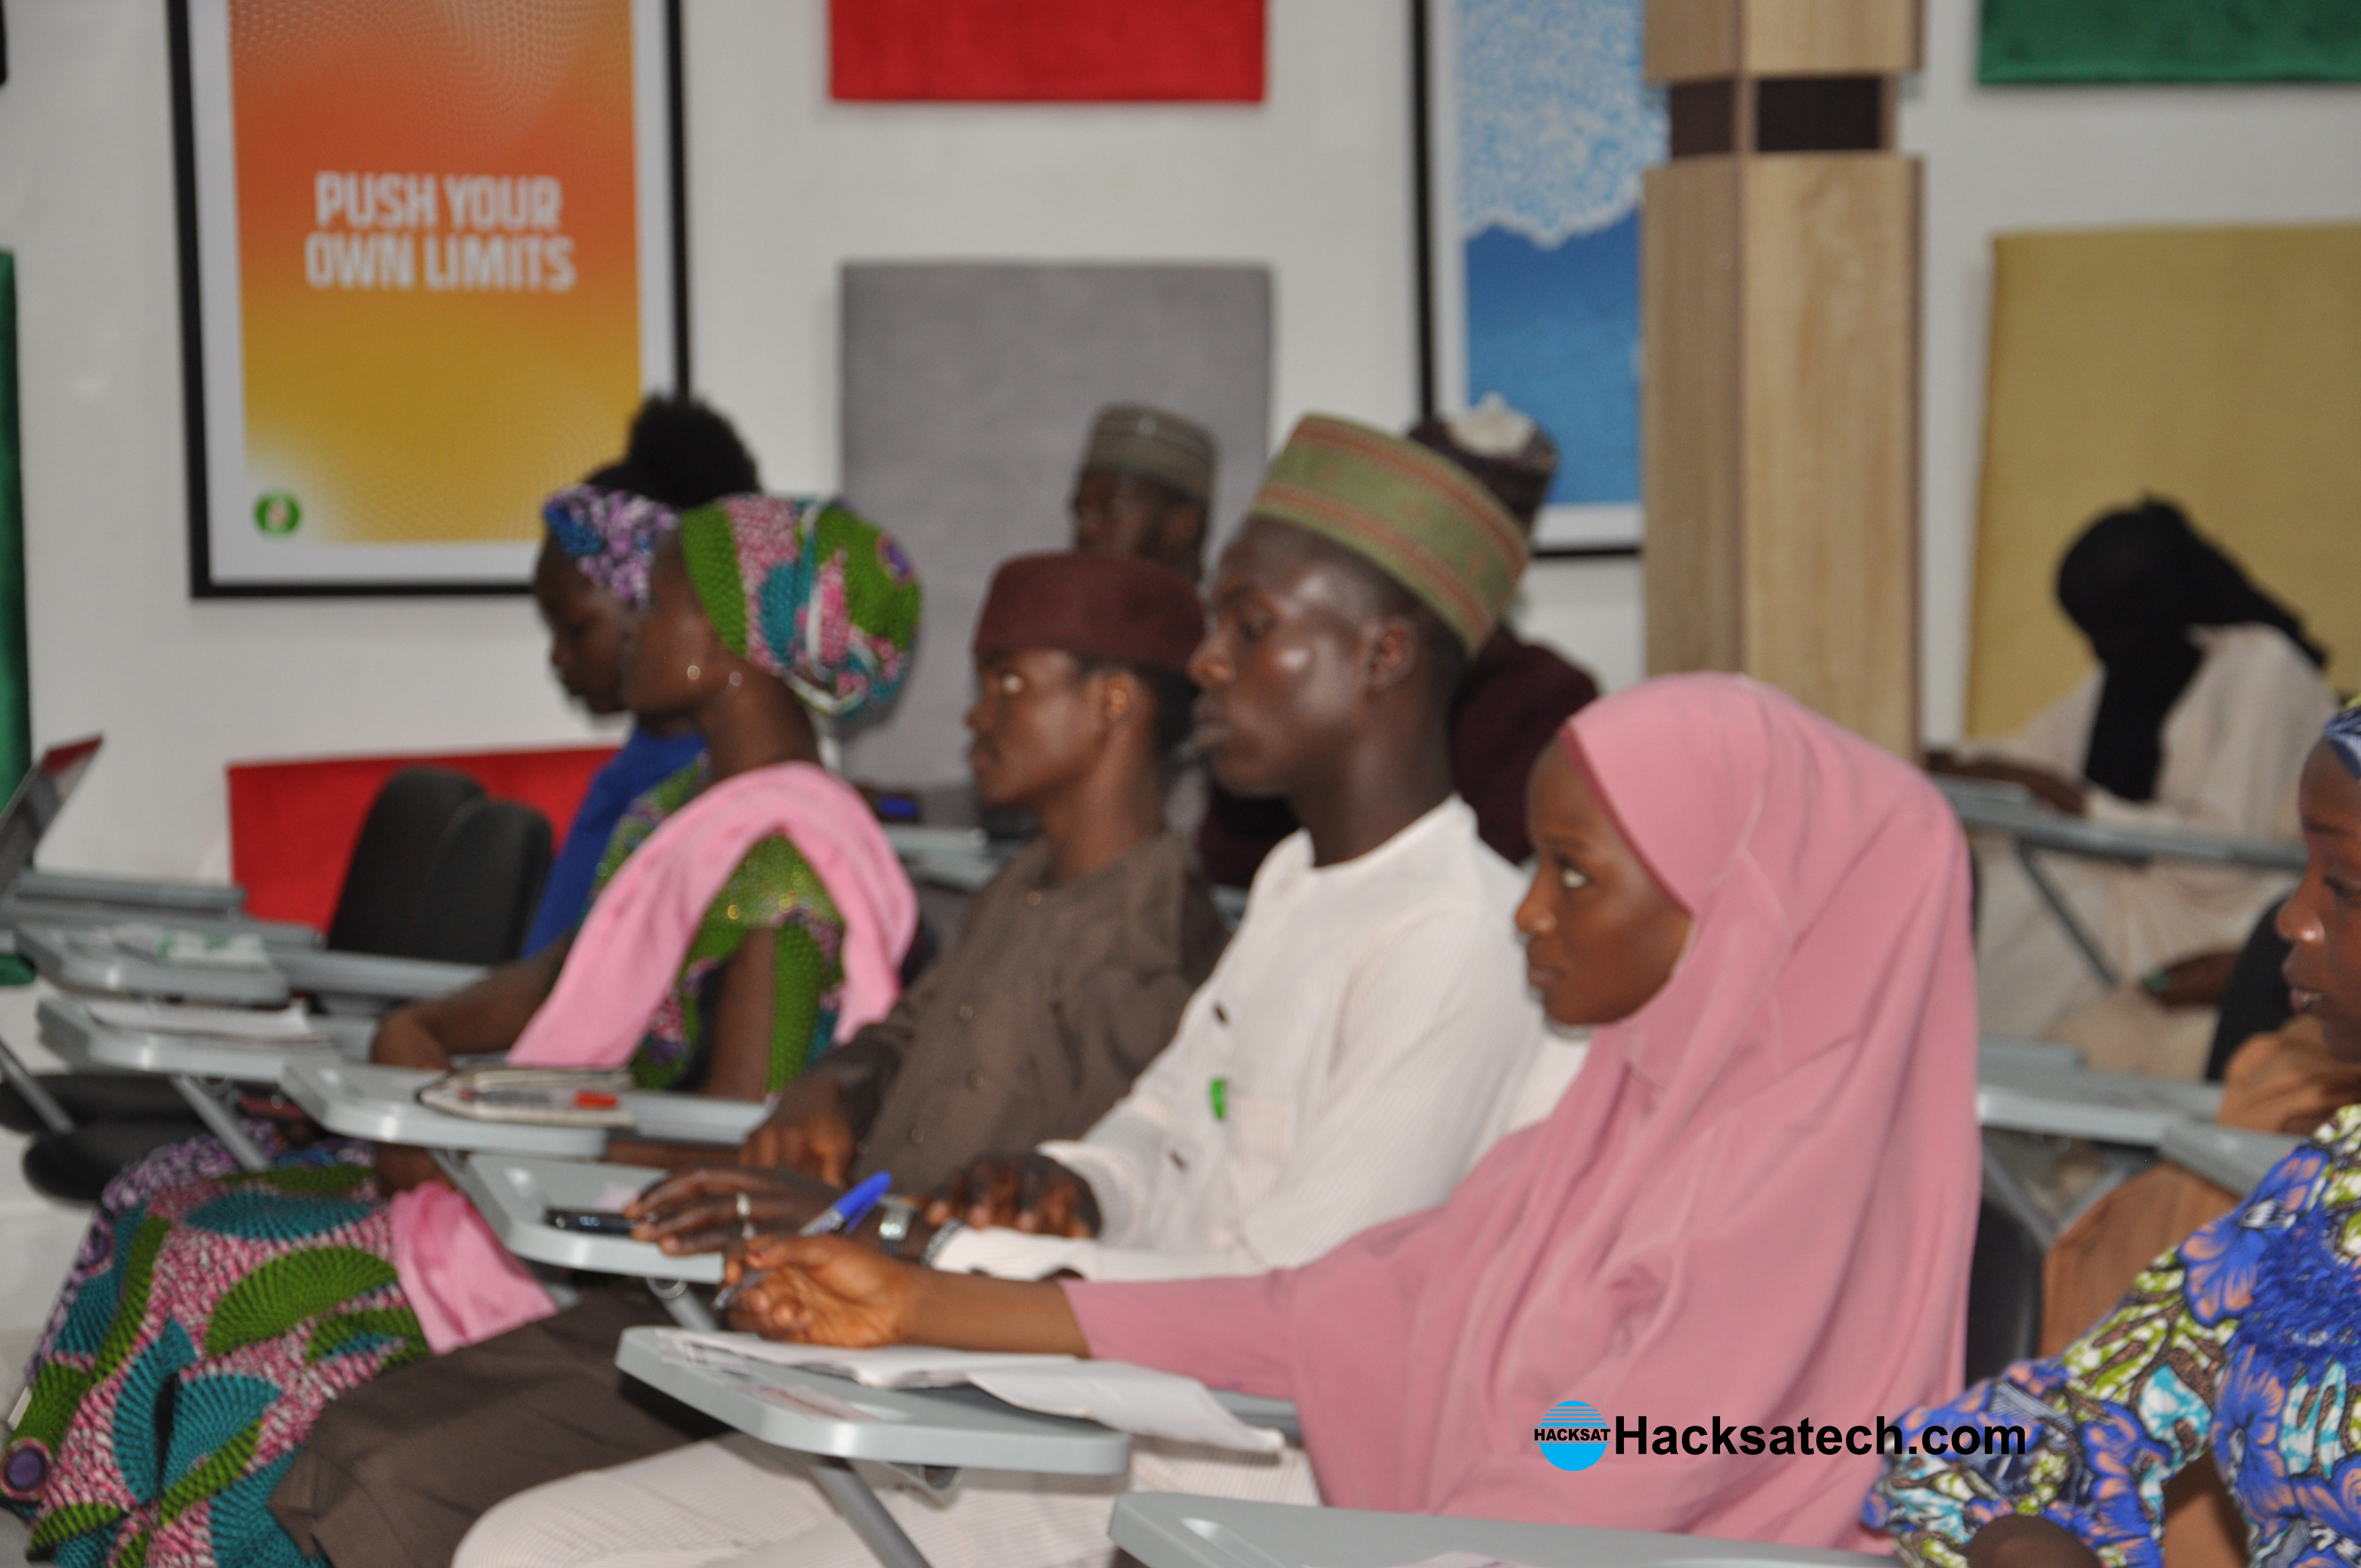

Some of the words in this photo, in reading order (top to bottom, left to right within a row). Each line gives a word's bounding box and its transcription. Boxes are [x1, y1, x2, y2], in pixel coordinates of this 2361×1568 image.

[316, 171, 438, 228] PUSH
[443, 173, 563, 231] YOUR
[305, 230, 414, 290] OWN
[424, 232, 577, 292] LIMITS
